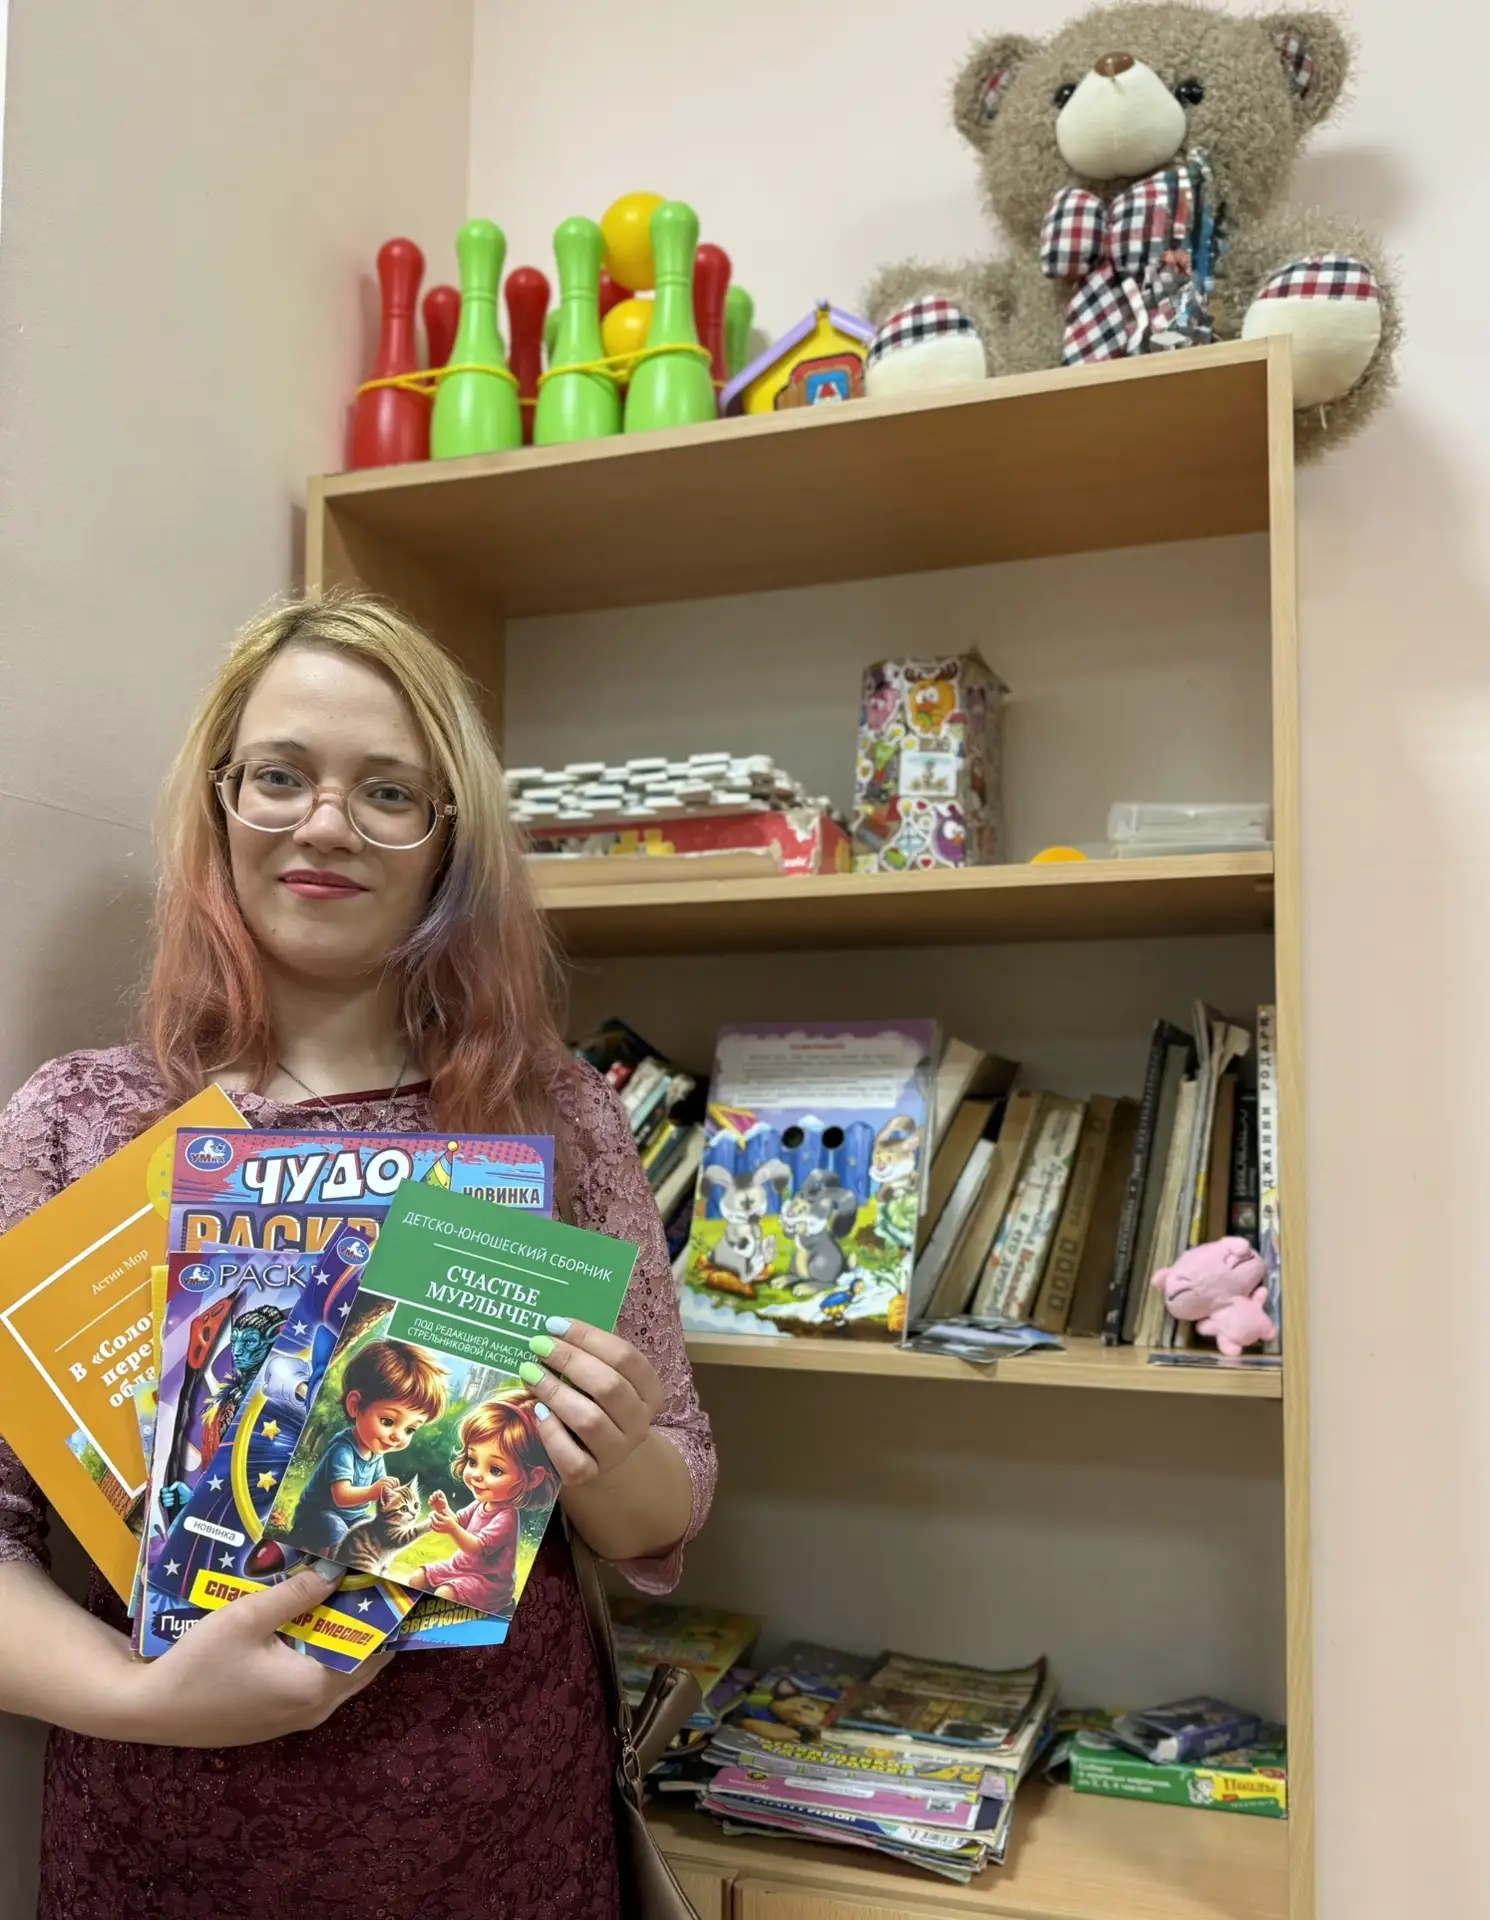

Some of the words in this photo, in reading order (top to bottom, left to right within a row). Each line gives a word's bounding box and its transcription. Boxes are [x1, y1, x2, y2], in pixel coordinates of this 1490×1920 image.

[243, 1147, 413, 1206] ЧУДО
[463, 1186, 541, 1204] НОВИНКА
[402, 1211, 549, 1263] ДЕТСКО-ЮНОШЕСКИЙ
[549, 1253, 613, 1282] СБОРНИК
[91, 1267, 125, 1295] Астин
[122, 1249, 149, 1271] Мор
[218, 1263, 318, 1291] РАСК
[446, 1265, 541, 1307] СЧАСТЬЕ
[425, 1281, 548, 1331] МУРЛЫЧЕТ
[68, 1362, 88, 1383] В
[92, 1311, 153, 1365] «Соло
[407, 1327, 485, 1357] СТРЕЛЬНИКОВОЙ
[414, 1317, 434, 1331] ПОД
[435, 1322, 489, 1347] РЕДАКЦИЕЙ
[100, 1338, 153, 1387] пере
[193, 1520, 236, 1541] новинка
